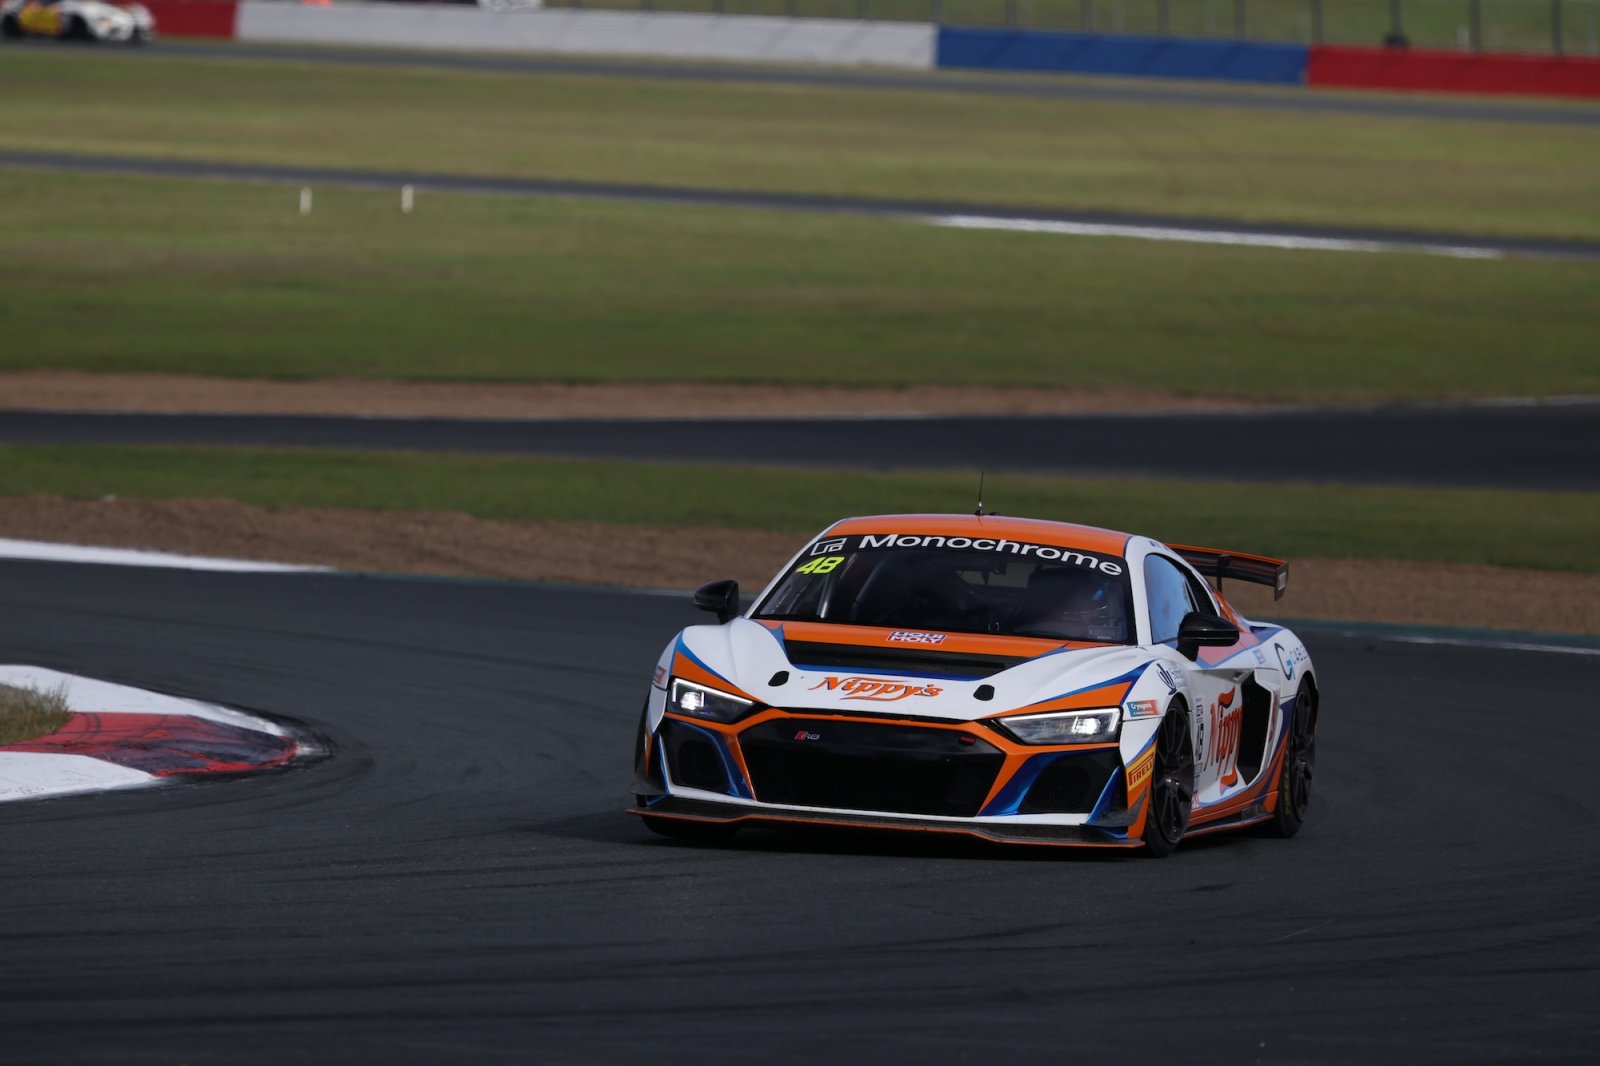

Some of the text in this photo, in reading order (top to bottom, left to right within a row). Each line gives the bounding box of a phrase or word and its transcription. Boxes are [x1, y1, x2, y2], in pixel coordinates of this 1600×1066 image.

[859, 534, 1122, 576] Monochrome
[796, 556, 845, 575] 48
[890, 636, 943, 645] MOLY
[892, 631, 945, 639] LIQUI
[808, 676, 944, 702] Nippy's
